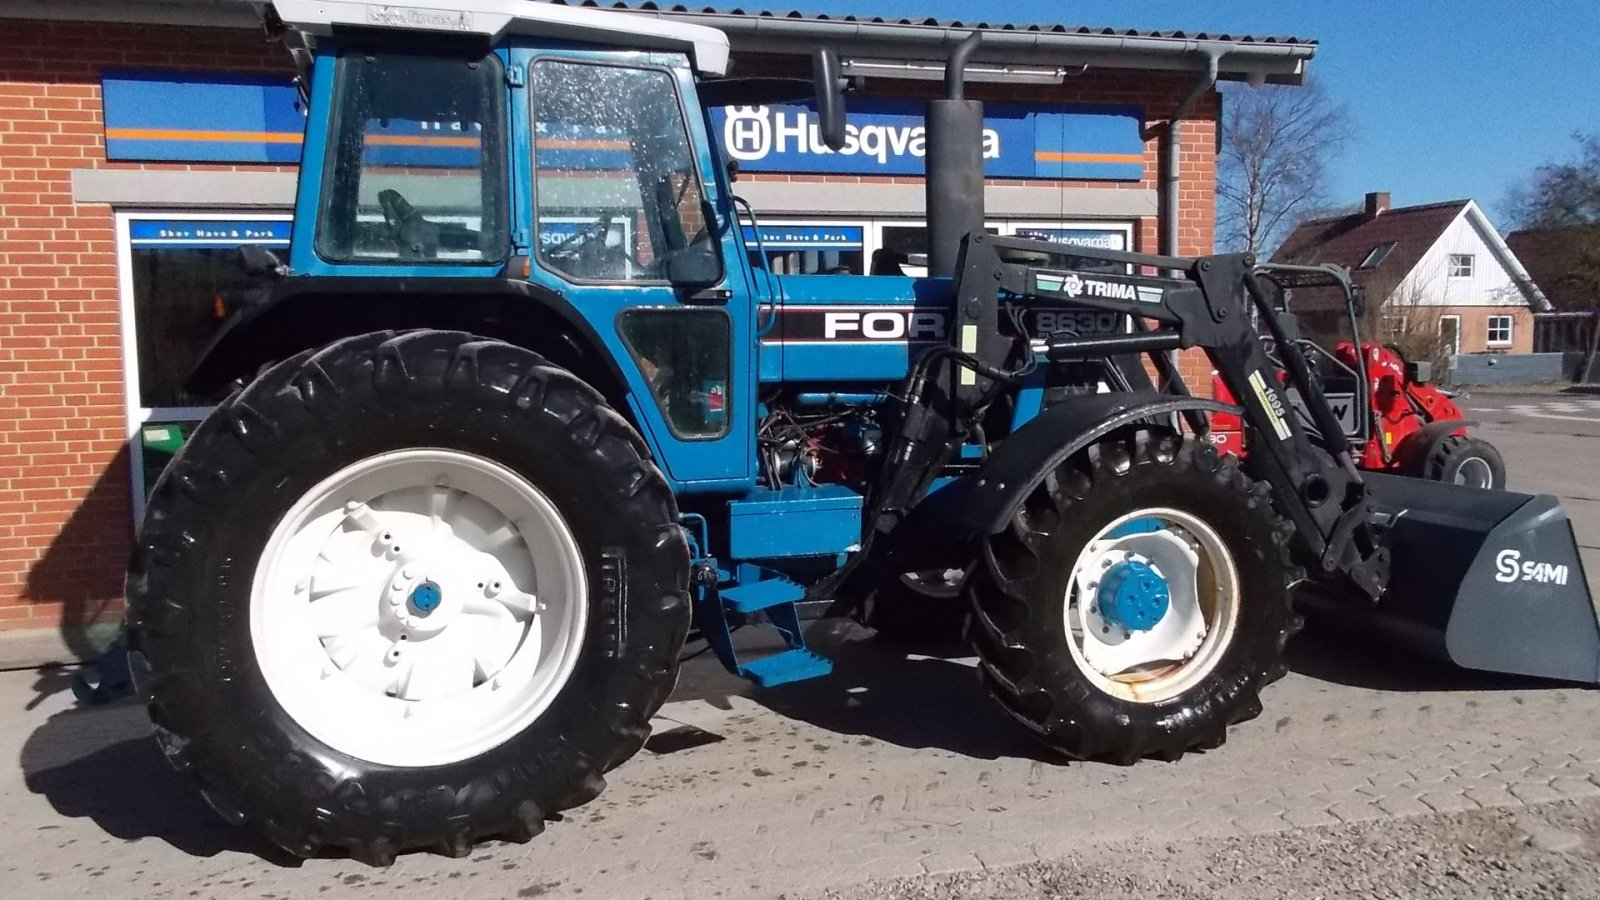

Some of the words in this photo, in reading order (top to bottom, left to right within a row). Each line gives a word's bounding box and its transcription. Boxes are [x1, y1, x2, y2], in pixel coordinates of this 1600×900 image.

[775, 112, 1000, 164] Husqvaa
[1085, 279, 1137, 301] TRIMA
[825, 312, 946, 339] FOR
[1036, 312, 1116, 333] 8630
[1265, 388, 1286, 417] 1695
[1522, 561, 1569, 585] SAMI
